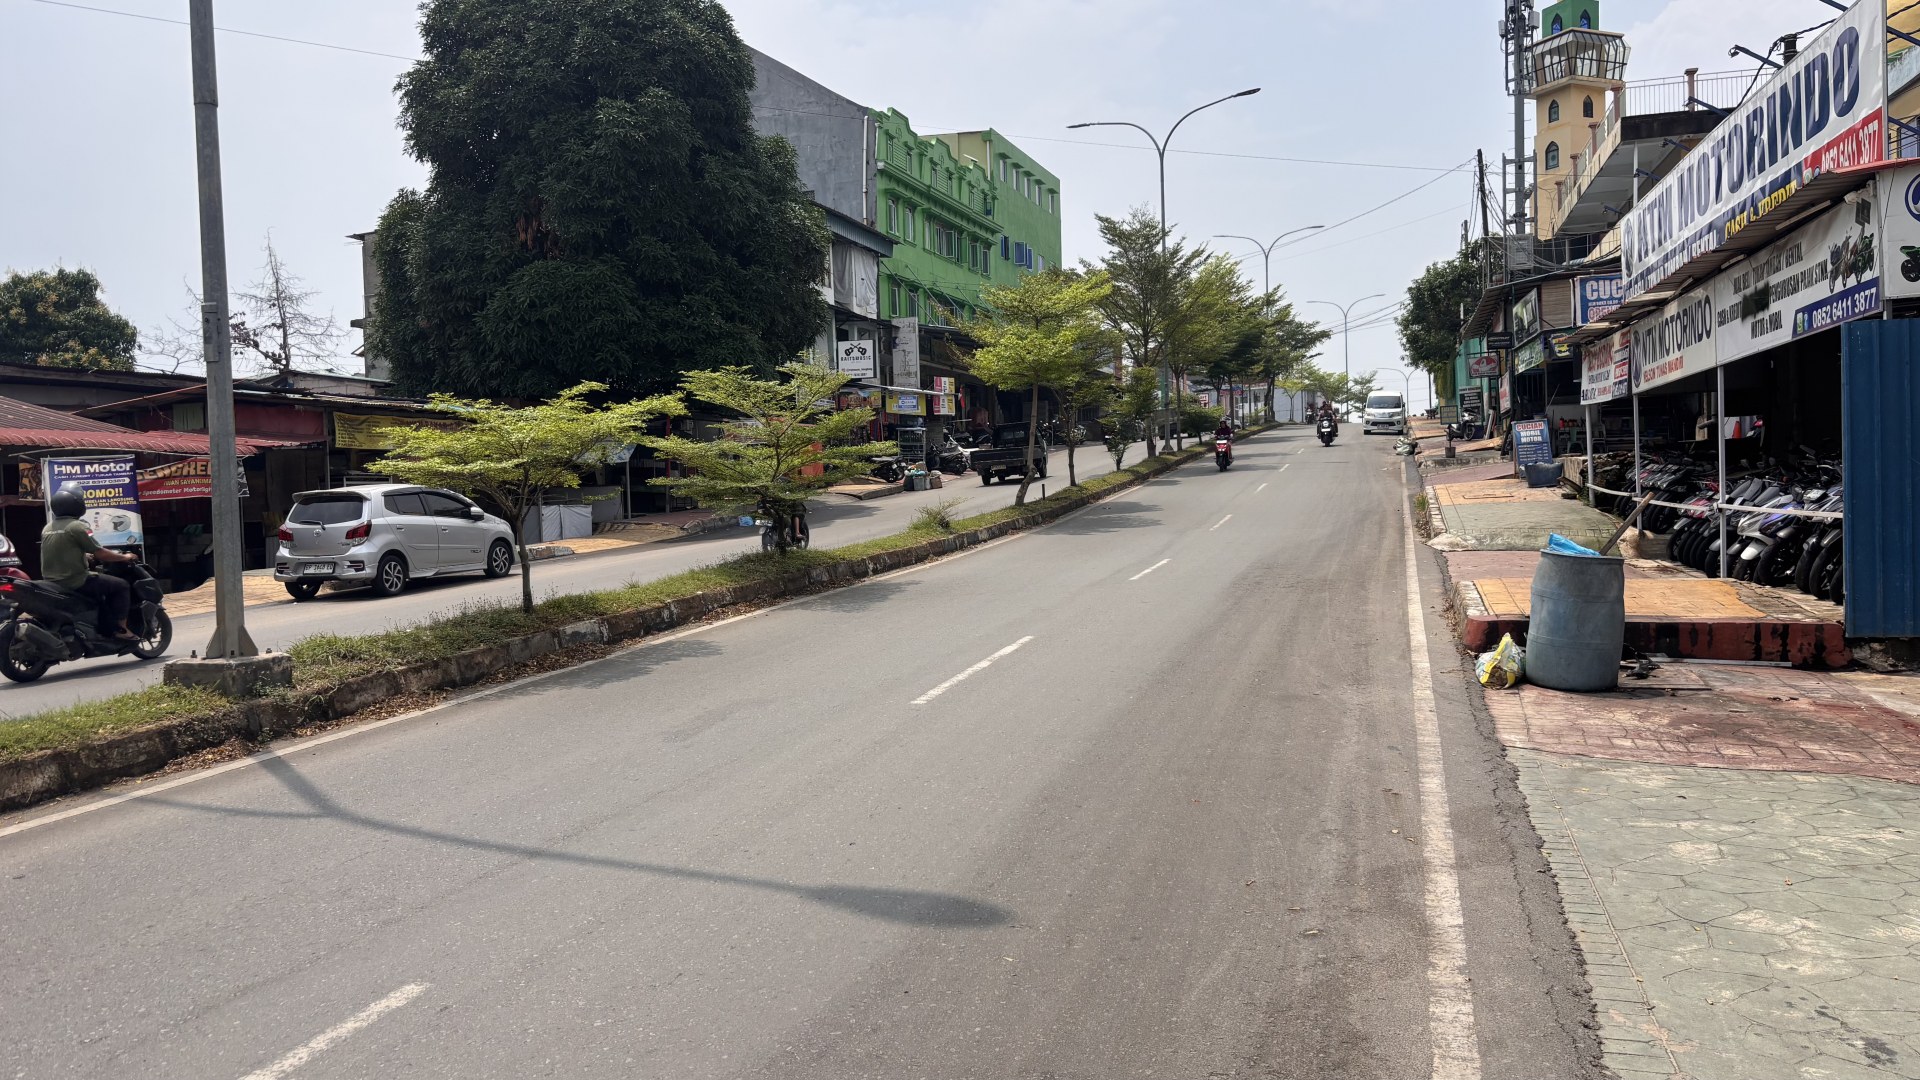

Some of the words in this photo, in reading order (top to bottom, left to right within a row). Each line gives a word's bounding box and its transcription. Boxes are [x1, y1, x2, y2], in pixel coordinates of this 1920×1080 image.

[1677, 26, 1860, 233] MOTORINDO
[1839, 132, 1857, 167] 6411
[1859, 119, 1878, 164] 3877
[1658, 294, 1712, 361] MOTORINDO
[1812, 305, 1831, 328] 0852
[1832, 296, 1852, 321] 6411
[1854, 287, 1877, 313] 3877
[53, 464, 80, 475] HM
[85, 462, 134, 473] Motor
